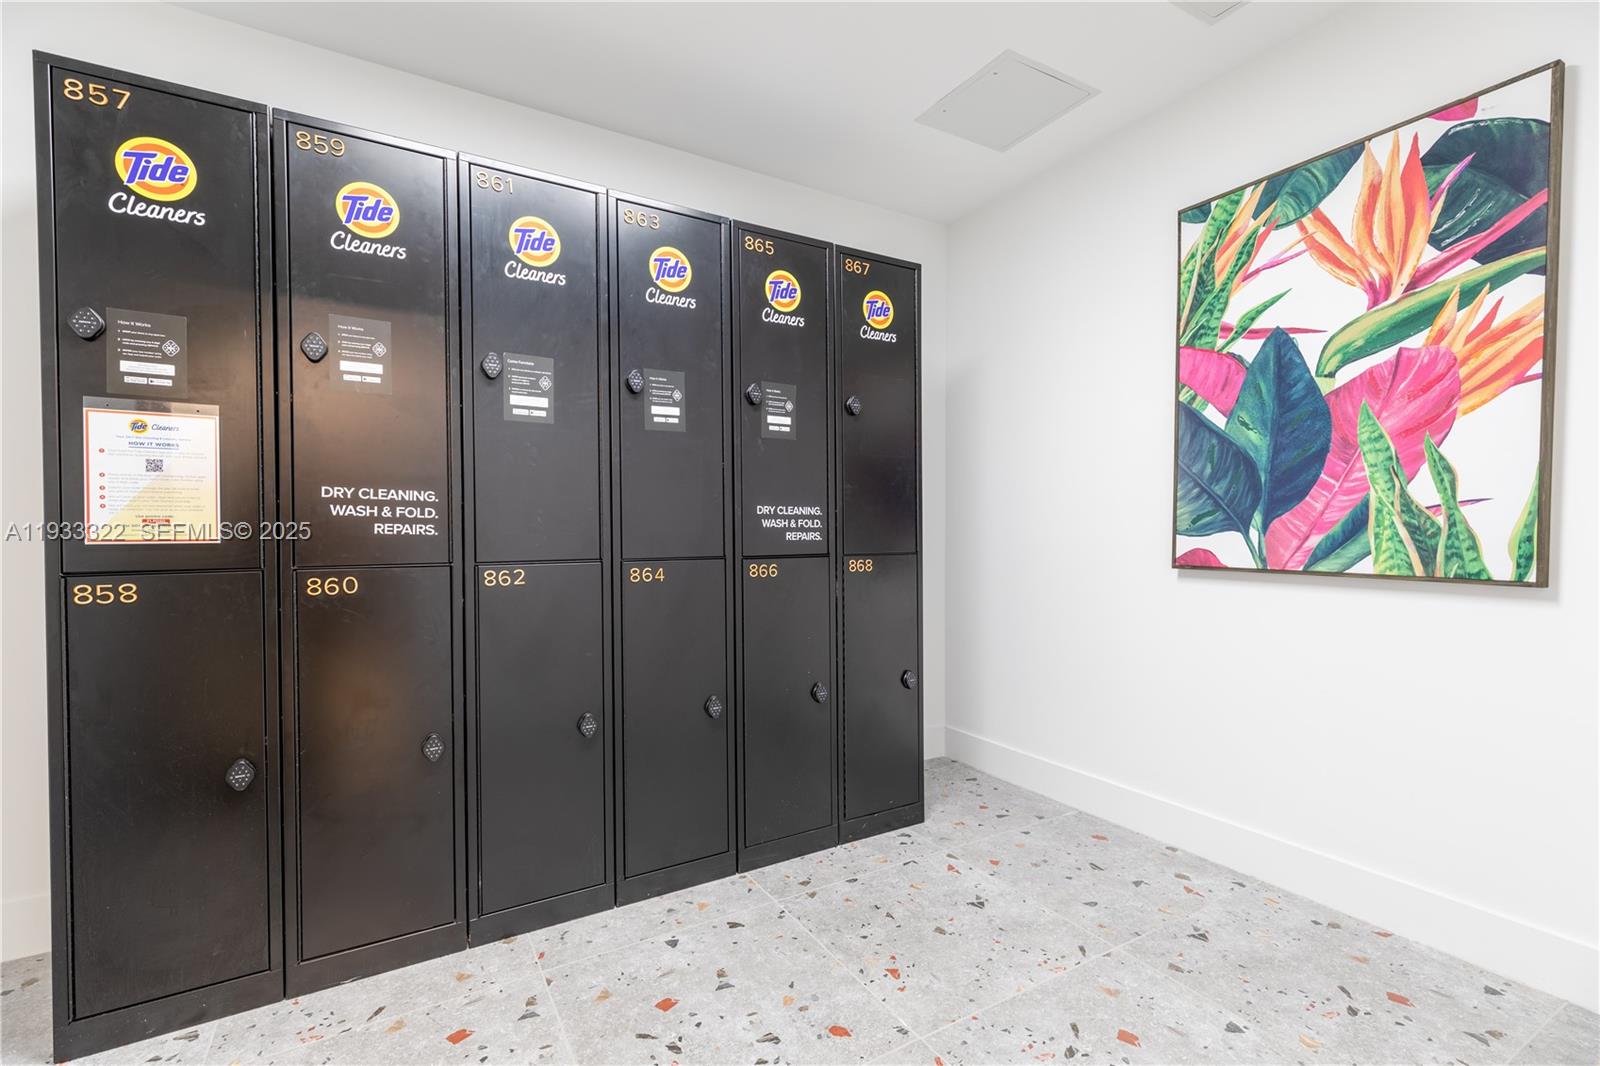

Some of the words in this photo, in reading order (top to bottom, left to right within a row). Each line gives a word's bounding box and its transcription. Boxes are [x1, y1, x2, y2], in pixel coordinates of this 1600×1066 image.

[63, 78, 131, 110] 857
[295, 130, 346, 158] 859
[122, 150, 190, 185] Tide
[475, 170, 515, 194] 861
[107, 191, 206, 226] Cleaners
[341, 194, 394, 225] Tide
[623, 208, 660, 230] 863
[330, 230, 407, 260] Cleaners
[513, 227, 557, 255] Tide
[744, 235, 775, 256] 865
[504, 260, 567, 287] Cleaners
[653, 256, 689, 282] Tide
[844, 258, 871, 276] 867
[645, 286, 697, 310] Cleaners
[768, 279, 798, 303] Tide
[761, 306, 806, 328] Cleaners
[865, 299, 891, 321] Tide
[859, 324, 898, 343] Cleaners
[130, 422, 148, 431] Tide
[151, 423, 180, 432] Cleaners
[321, 485, 355, 499] DRY
[358, 487, 439, 502] CLEANING.
[329, 503, 378, 517] WASH
[381, 505, 393, 518] &
[395, 506, 439, 519] FOLD.
[756, 505, 776, 515] DRY
[777, 505, 823, 516] CLEANING.
[373, 522, 439, 536] REPAIRS.
[761, 518, 789, 528] WASH
[789, 518, 797, 528] &
[797, 518, 823, 528] FOLD.
[785, 531, 823, 541] REPAIRS.
[629, 567, 665, 583] 864
[748, 563, 778, 578] 866
[848, 558, 873, 572] 868
[306, 575, 359, 597] 860
[483, 568, 526, 586] 862
[72, 582, 139, 605] 858
